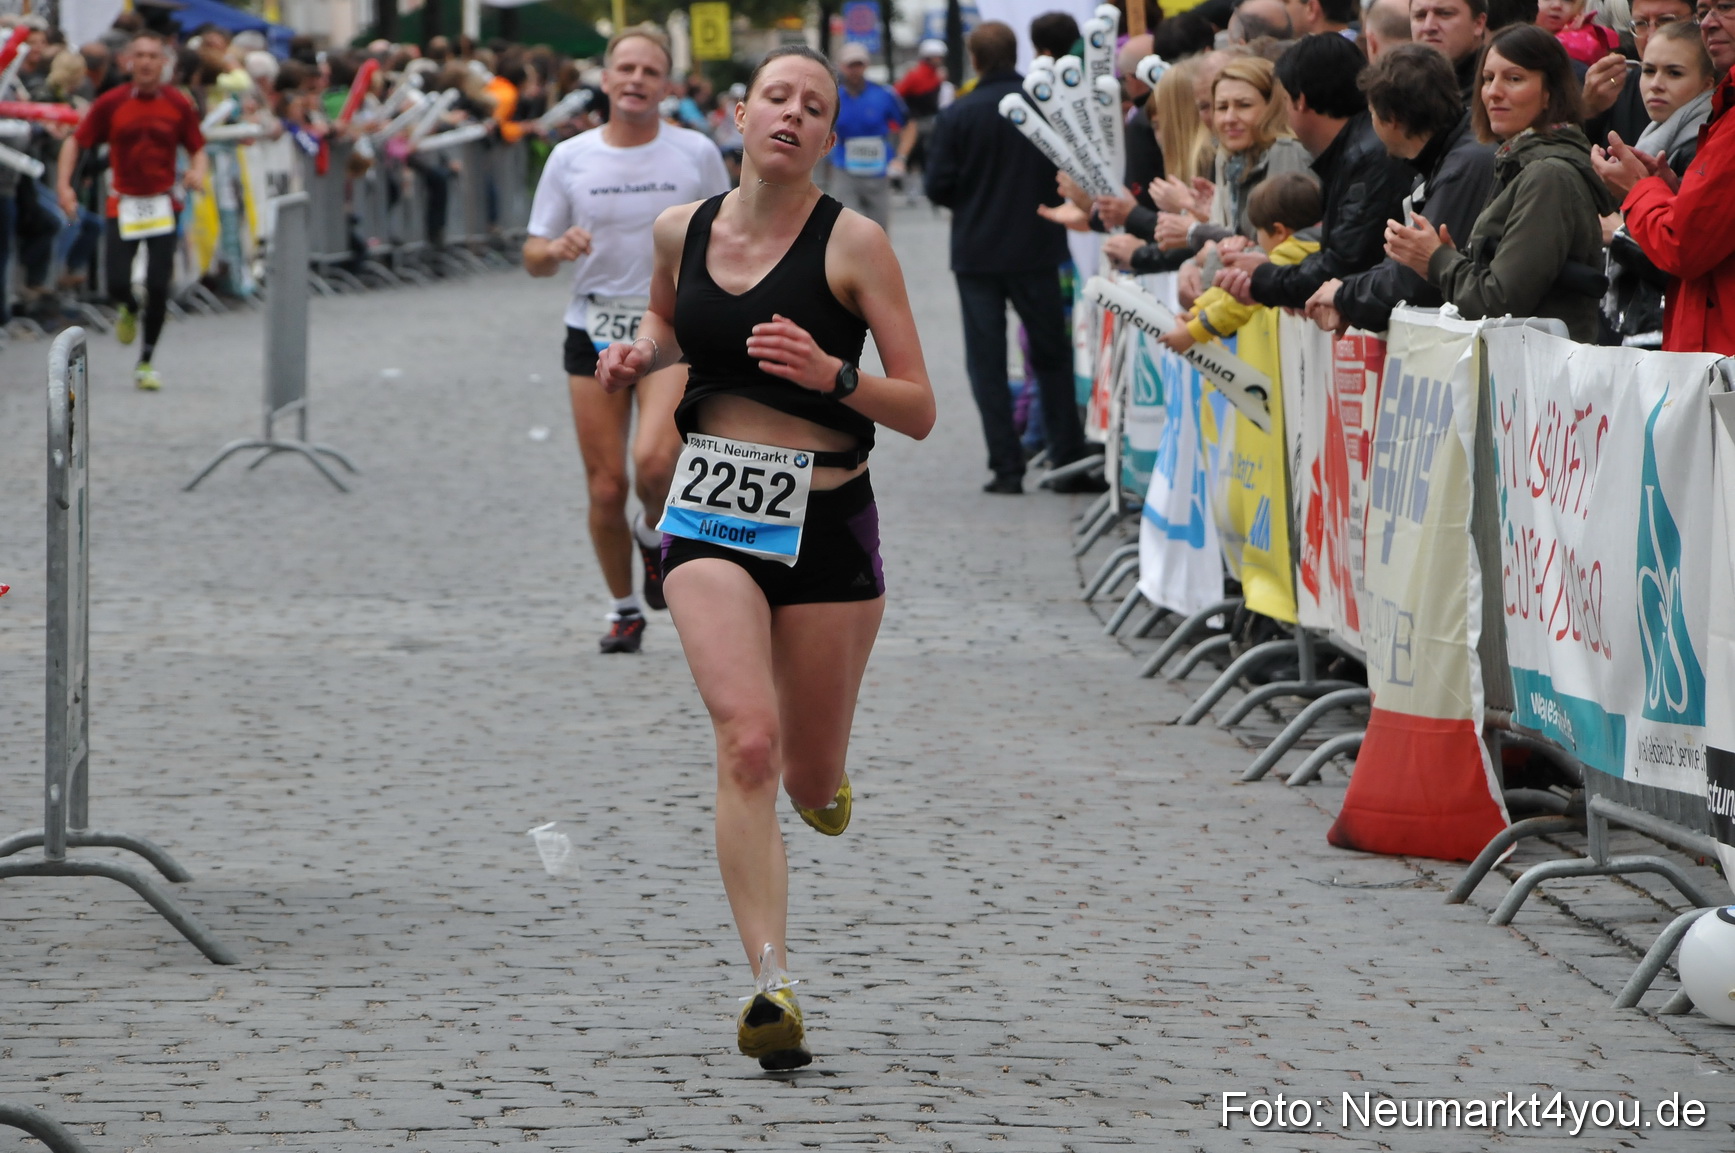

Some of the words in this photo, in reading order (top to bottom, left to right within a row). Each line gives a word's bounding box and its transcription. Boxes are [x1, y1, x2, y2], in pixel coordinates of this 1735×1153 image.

[723, 443, 789, 465] Neumarkt
[680, 456, 797, 519] 2252
[698, 518, 757, 545] Nicole
